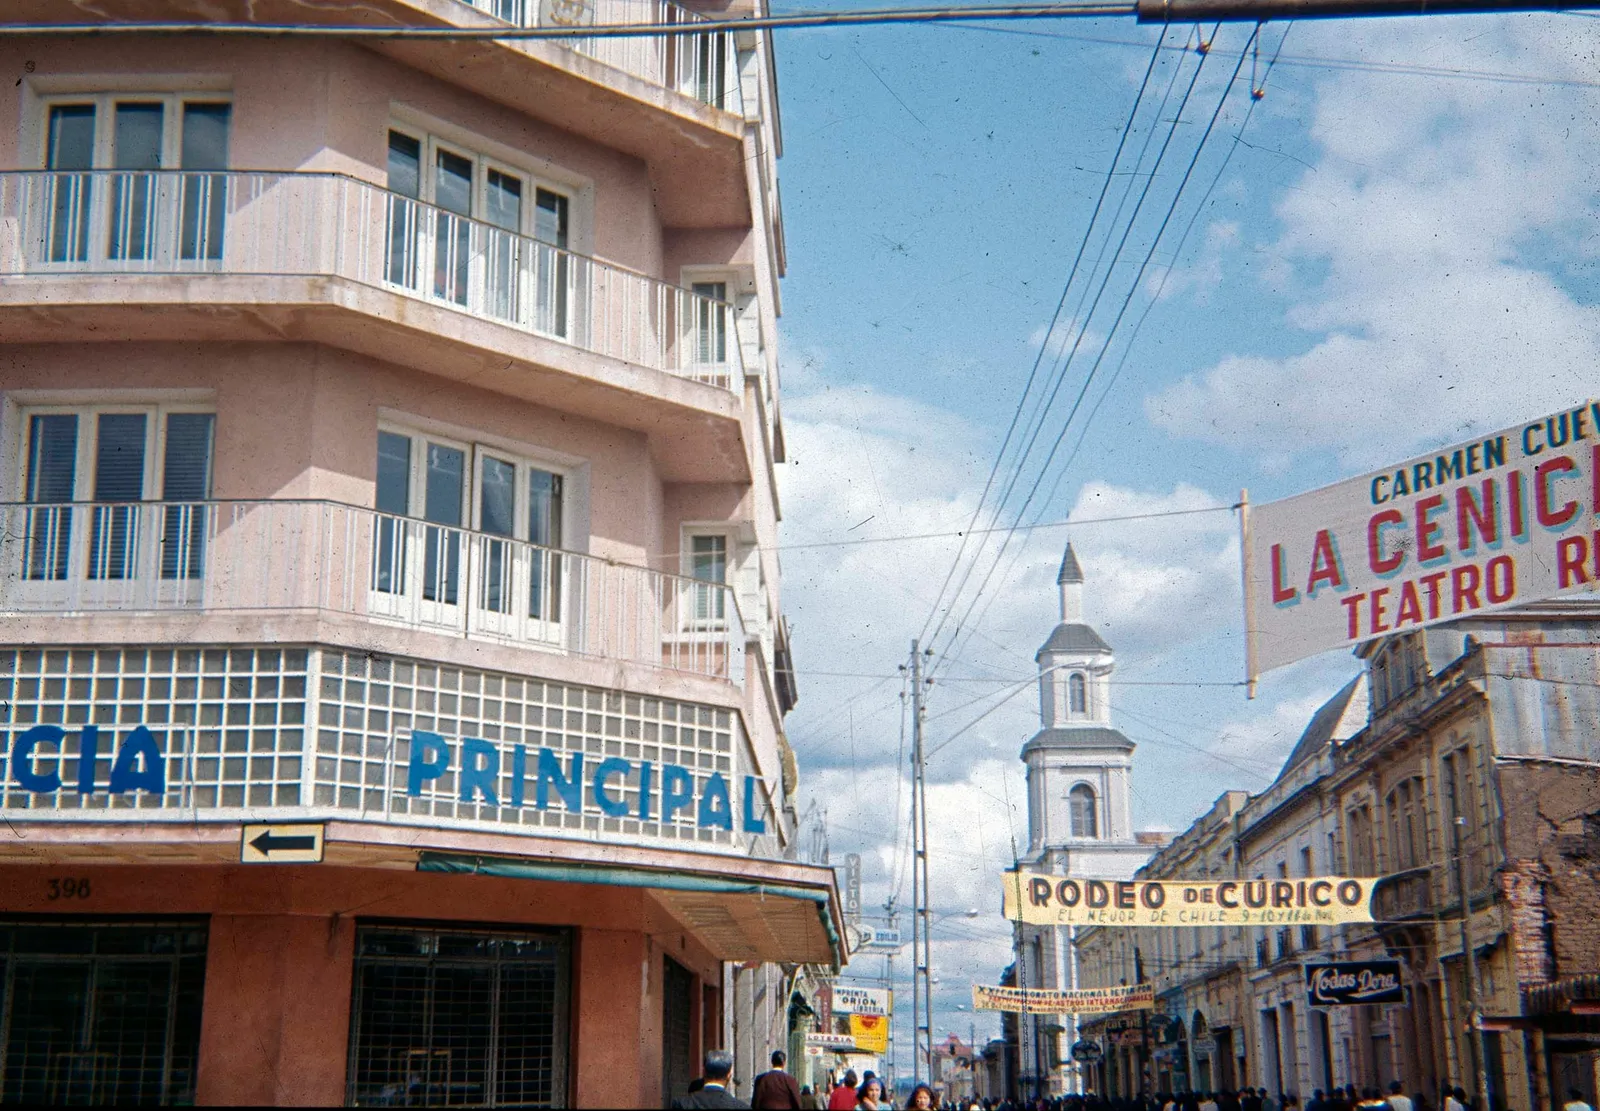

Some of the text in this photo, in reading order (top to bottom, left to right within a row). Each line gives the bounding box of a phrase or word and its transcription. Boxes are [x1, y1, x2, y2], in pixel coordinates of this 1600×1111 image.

[1371, 435, 1508, 505] CARMEN
[1271, 529, 1350, 607] LA
[1341, 554, 1516, 640] TEATRO
[12, 725, 765, 834] CIA PRINCIPAL
[48, 878, 91, 899] 398
[1028, 877, 1362, 910] RODEO DE CURICO
[1057, 908, 1075, 922] EL
[1151, 910, 1166, 923] DE
[1178, 910, 1228, 923] CHILE
[834, 988, 867, 998] IMPRENTA
[842, 996, 877, 1006] ORION
[1062, 990, 1108, 999] NACIONAL
[853, 1005, 884, 1014] LIBRERIA
[808, 1035, 852, 1043] LOTERIA
